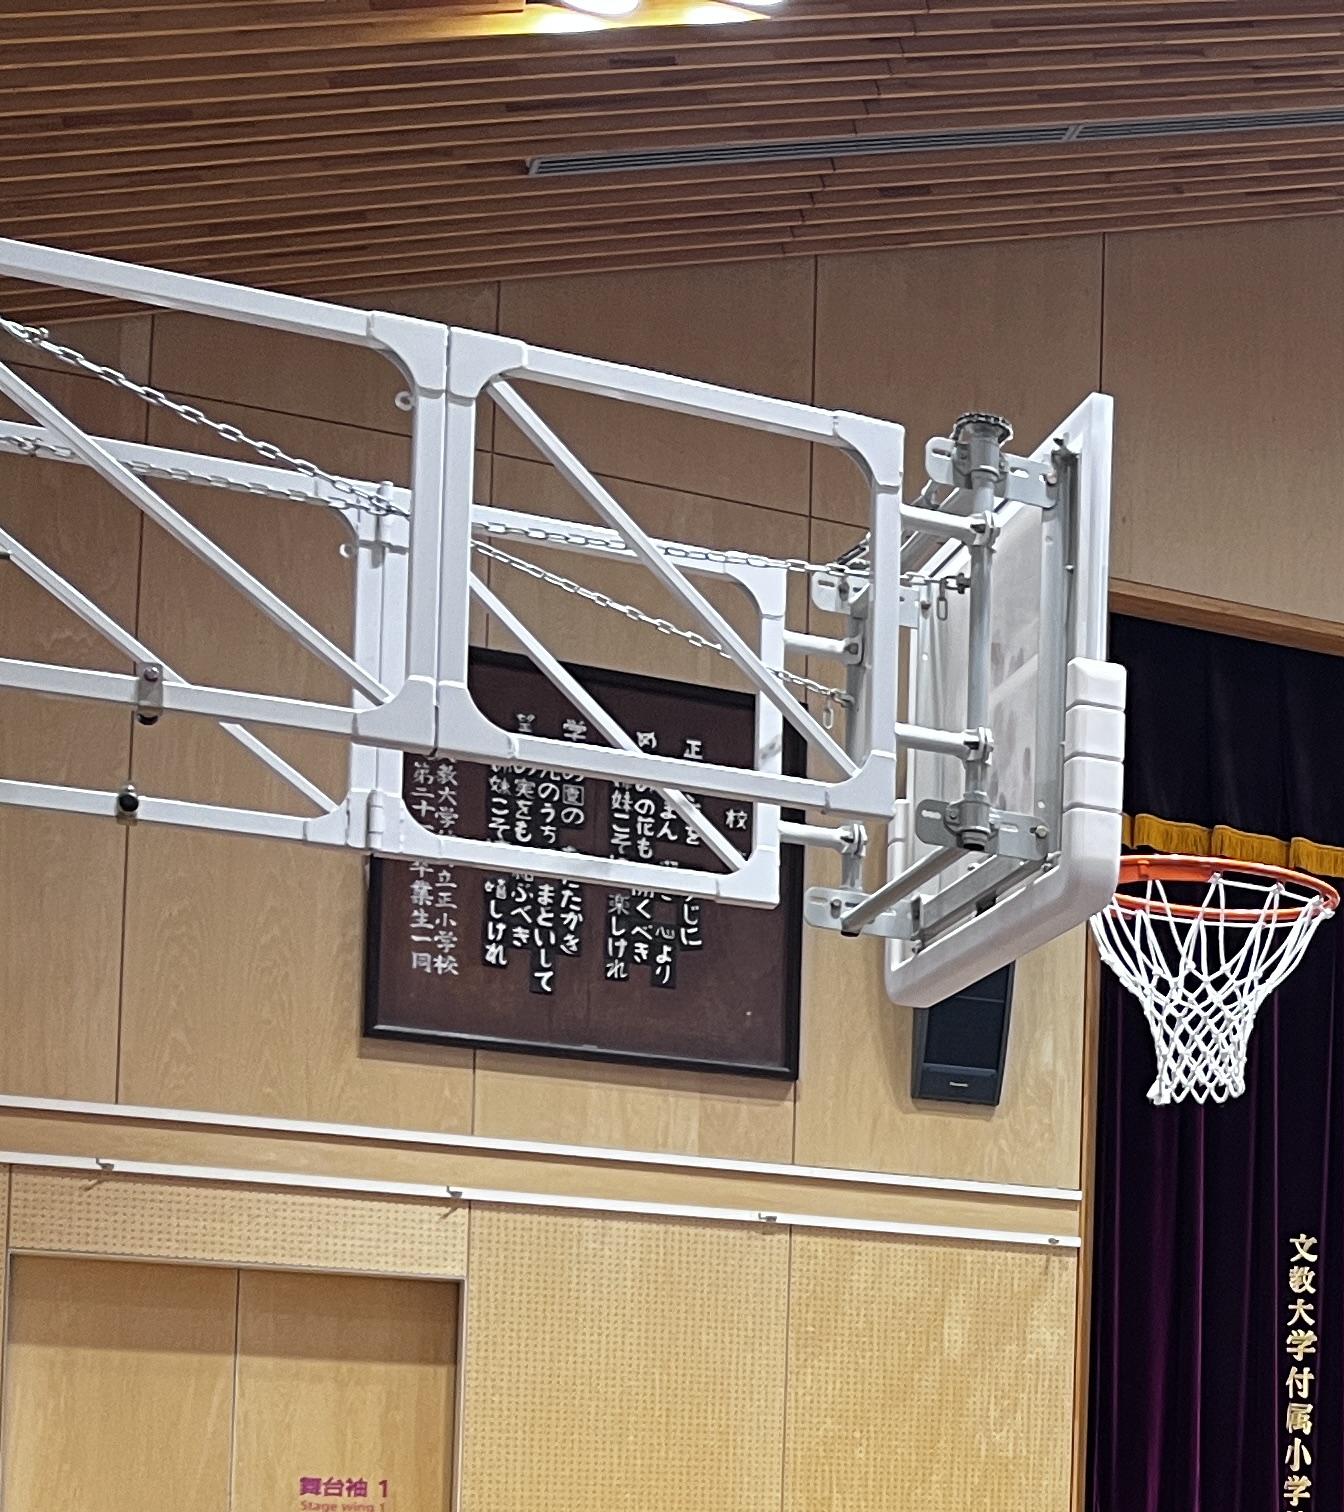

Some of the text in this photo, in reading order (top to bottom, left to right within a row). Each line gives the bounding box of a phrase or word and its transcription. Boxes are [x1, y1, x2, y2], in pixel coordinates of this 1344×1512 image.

[488, 764, 511, 844] 妹こそ
[433, 758, 460, 976] 教大学立正小学校
[605, 780, 634, 979] 妹こそ 楽しけれ
[533, 884, 556, 992] まといして
[560, 878, 584, 954] たかき
[630, 887, 654, 964] くべき
[655, 926, 676, 984] 心より
[378, 1479, 388, 1498] 1
